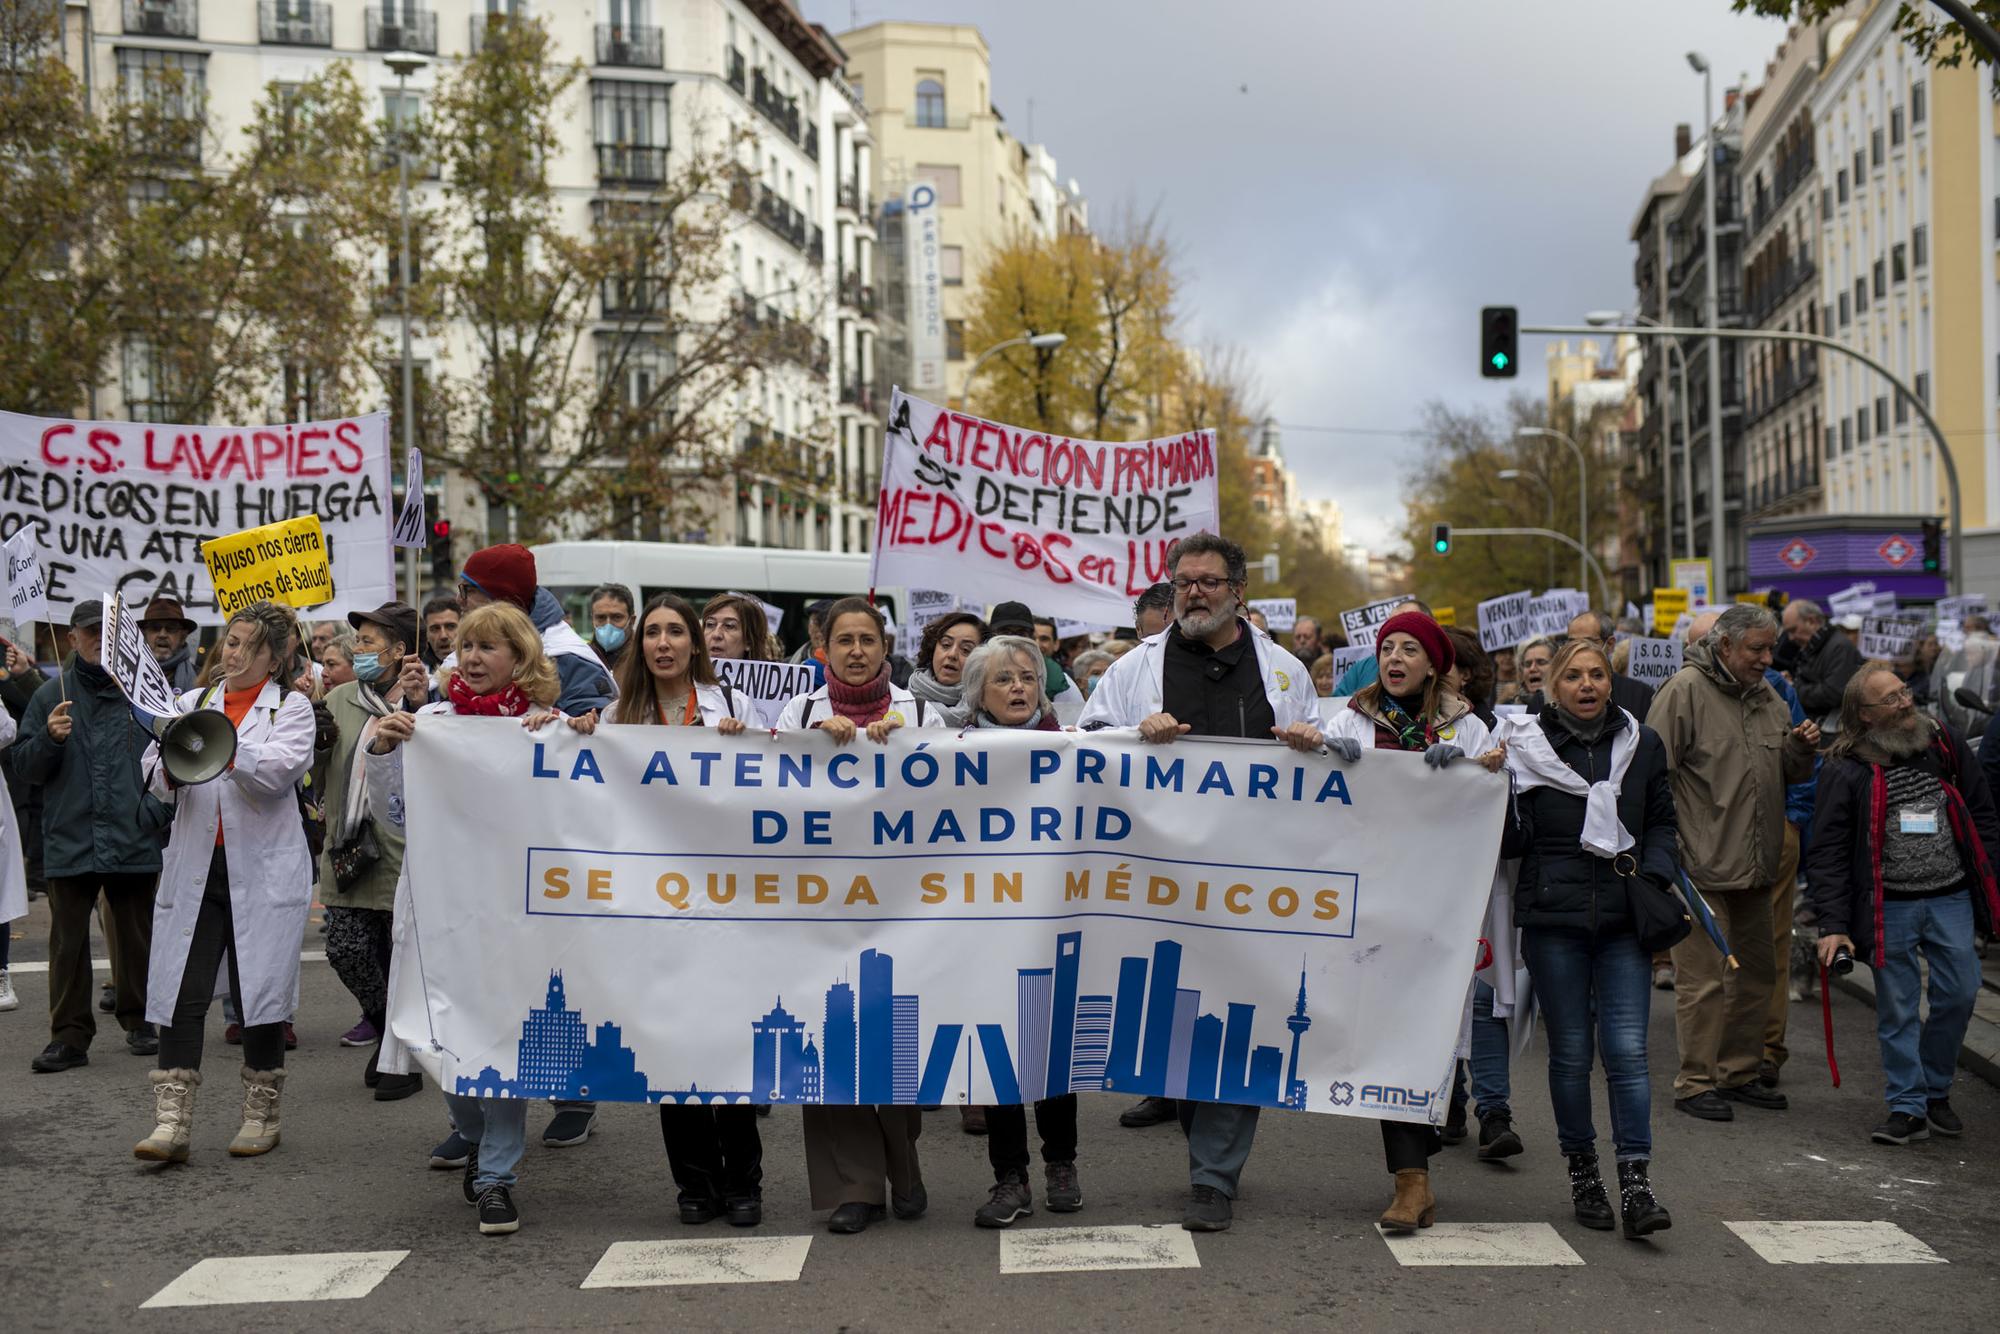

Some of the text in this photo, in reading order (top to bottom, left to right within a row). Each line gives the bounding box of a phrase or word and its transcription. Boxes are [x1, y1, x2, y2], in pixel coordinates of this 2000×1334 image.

[40, 424, 126, 473] C.S.
[923, 411, 1104, 490] ATENCIÓN
[1112, 429, 1216, 497] PRIMARIA
[975, 474, 1193, 535] DEFIENDE
[60, 523, 128, 561] UNA
[208, 530, 320, 583] ¡Ayuso nos cierra
[1078, 554, 1117, 587] en
[1126, 537, 1182, 597] LUC
[217, 561, 329, 613] Centros de Salud!
[119, 603, 138, 665] VEND
[1346, 611, 1365, 630] SE
[1632, 663, 1678, 679] SANIDAD
[532, 742, 1353, 806] LA ATENCIÓN PRIMARIA
[752, 805, 1132, 846] DE MADRID
[543, 862, 1341, 921] SE QUEDA SIN MÉDICOS
